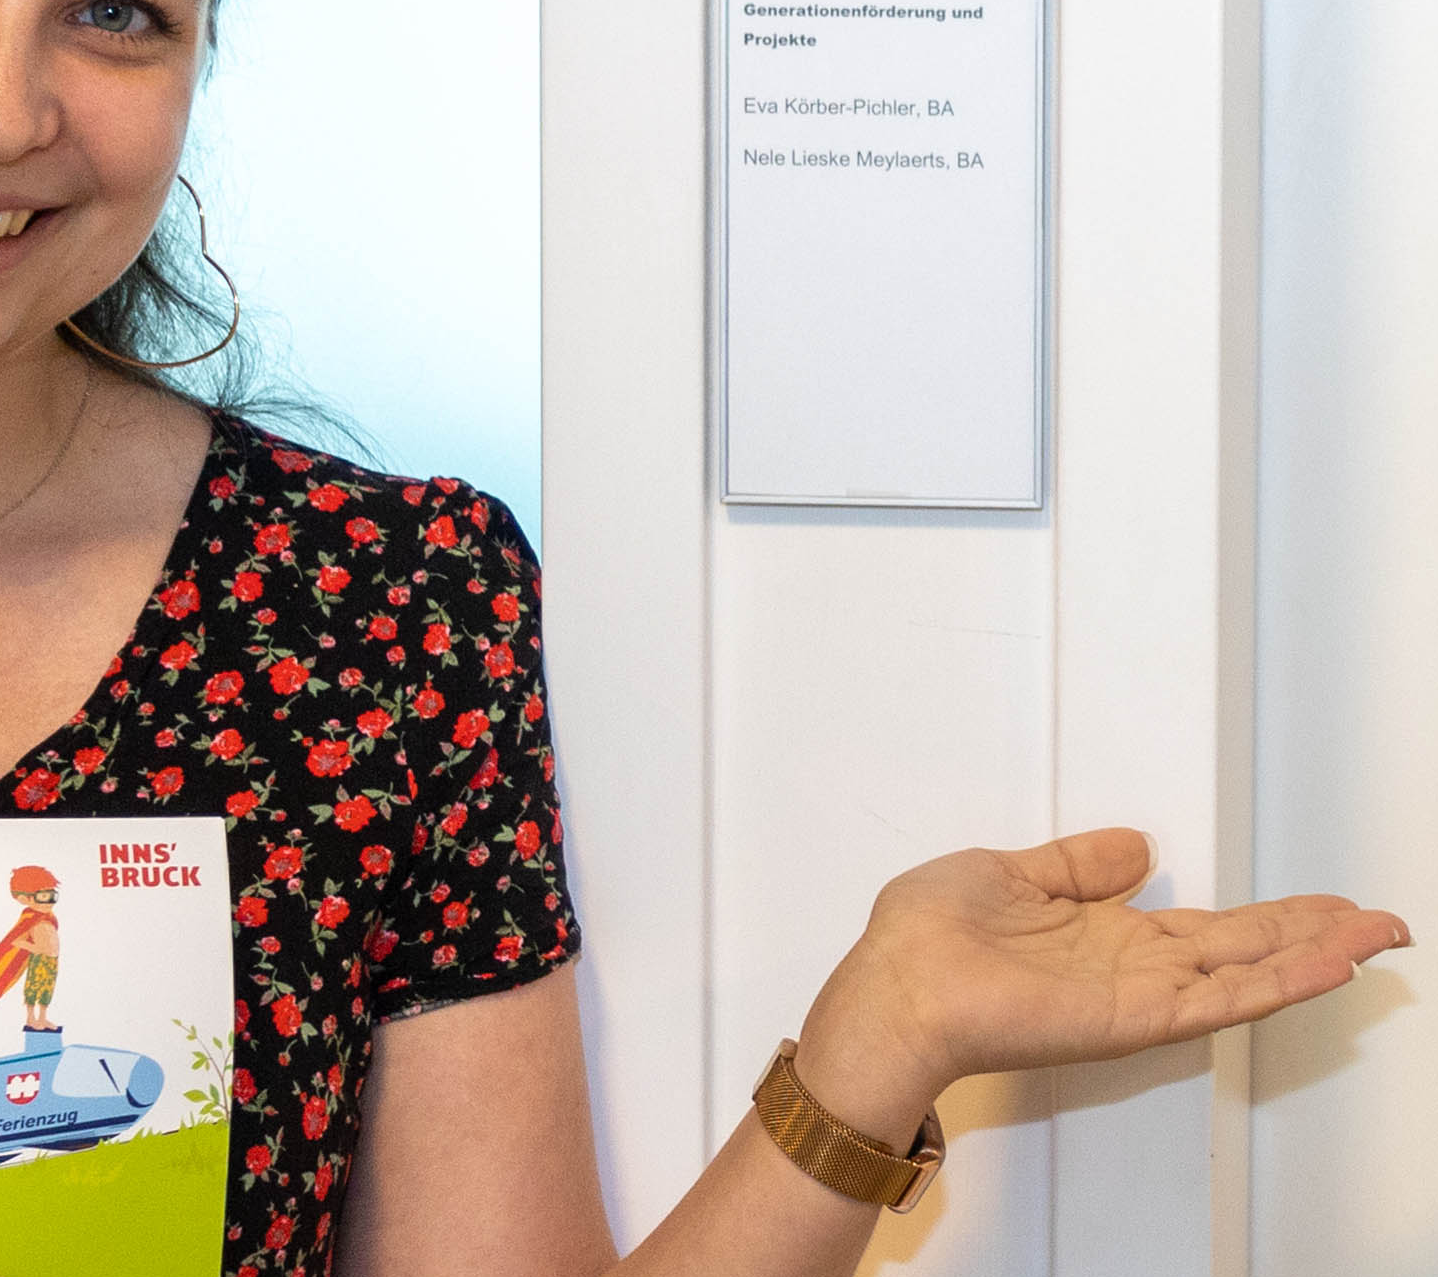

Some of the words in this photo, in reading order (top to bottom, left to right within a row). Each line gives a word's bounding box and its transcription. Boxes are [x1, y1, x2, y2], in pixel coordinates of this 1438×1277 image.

[743, 3, 946, 22] Generationenförderung
[952, 6, 984, 20] und
[743, 32, 817, 49] Projekte
[743, 98, 778, 116] Eva
[784, 97, 921, 119] Körber-Pichler,
[927, 101, 955, 117] BA
[743, 150, 786, 167] Nele
[791, 151, 850, 168] Lieske
[856, 152, 950, 171] Meylaerts,
[956, 153, 984, 169] BA
[101, 866, 201, 887] BRUCK
